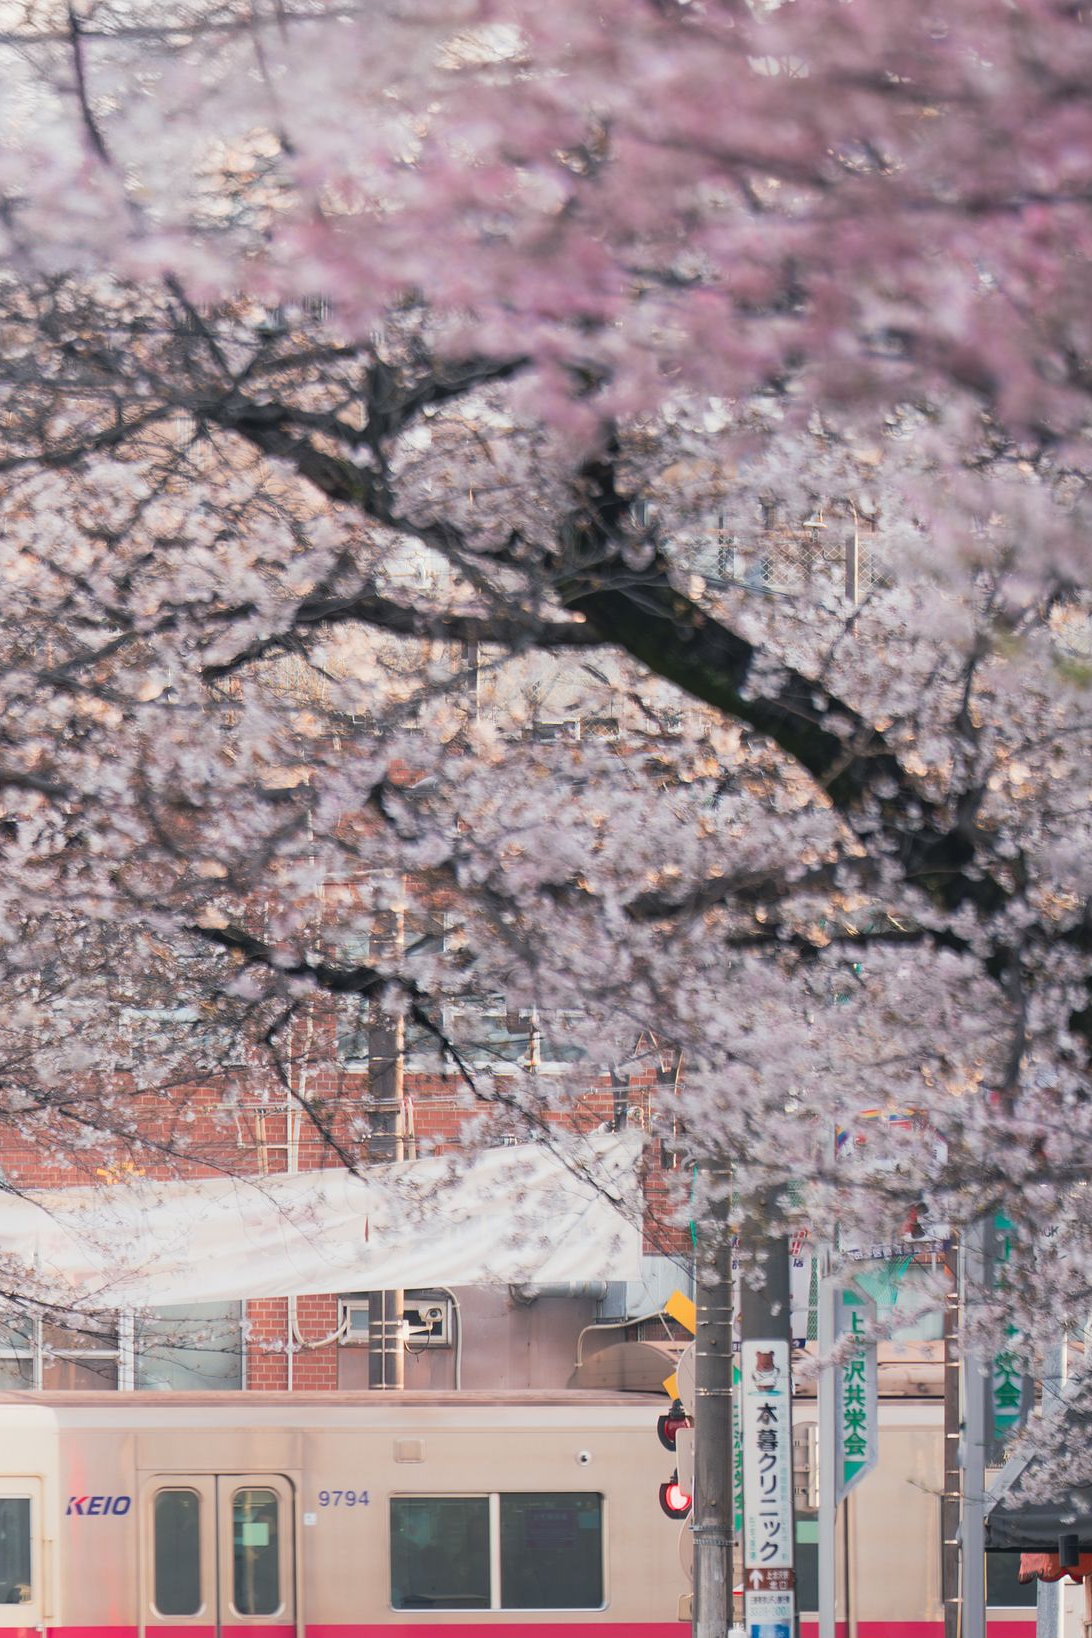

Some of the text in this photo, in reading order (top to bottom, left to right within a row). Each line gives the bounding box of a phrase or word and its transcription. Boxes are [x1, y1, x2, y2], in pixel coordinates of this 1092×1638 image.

[756, 1403, 780, 1562] 木暮クリニック
[66, 1496, 131, 1515] KEIO
[319, 1491, 370, 1506] 9794
